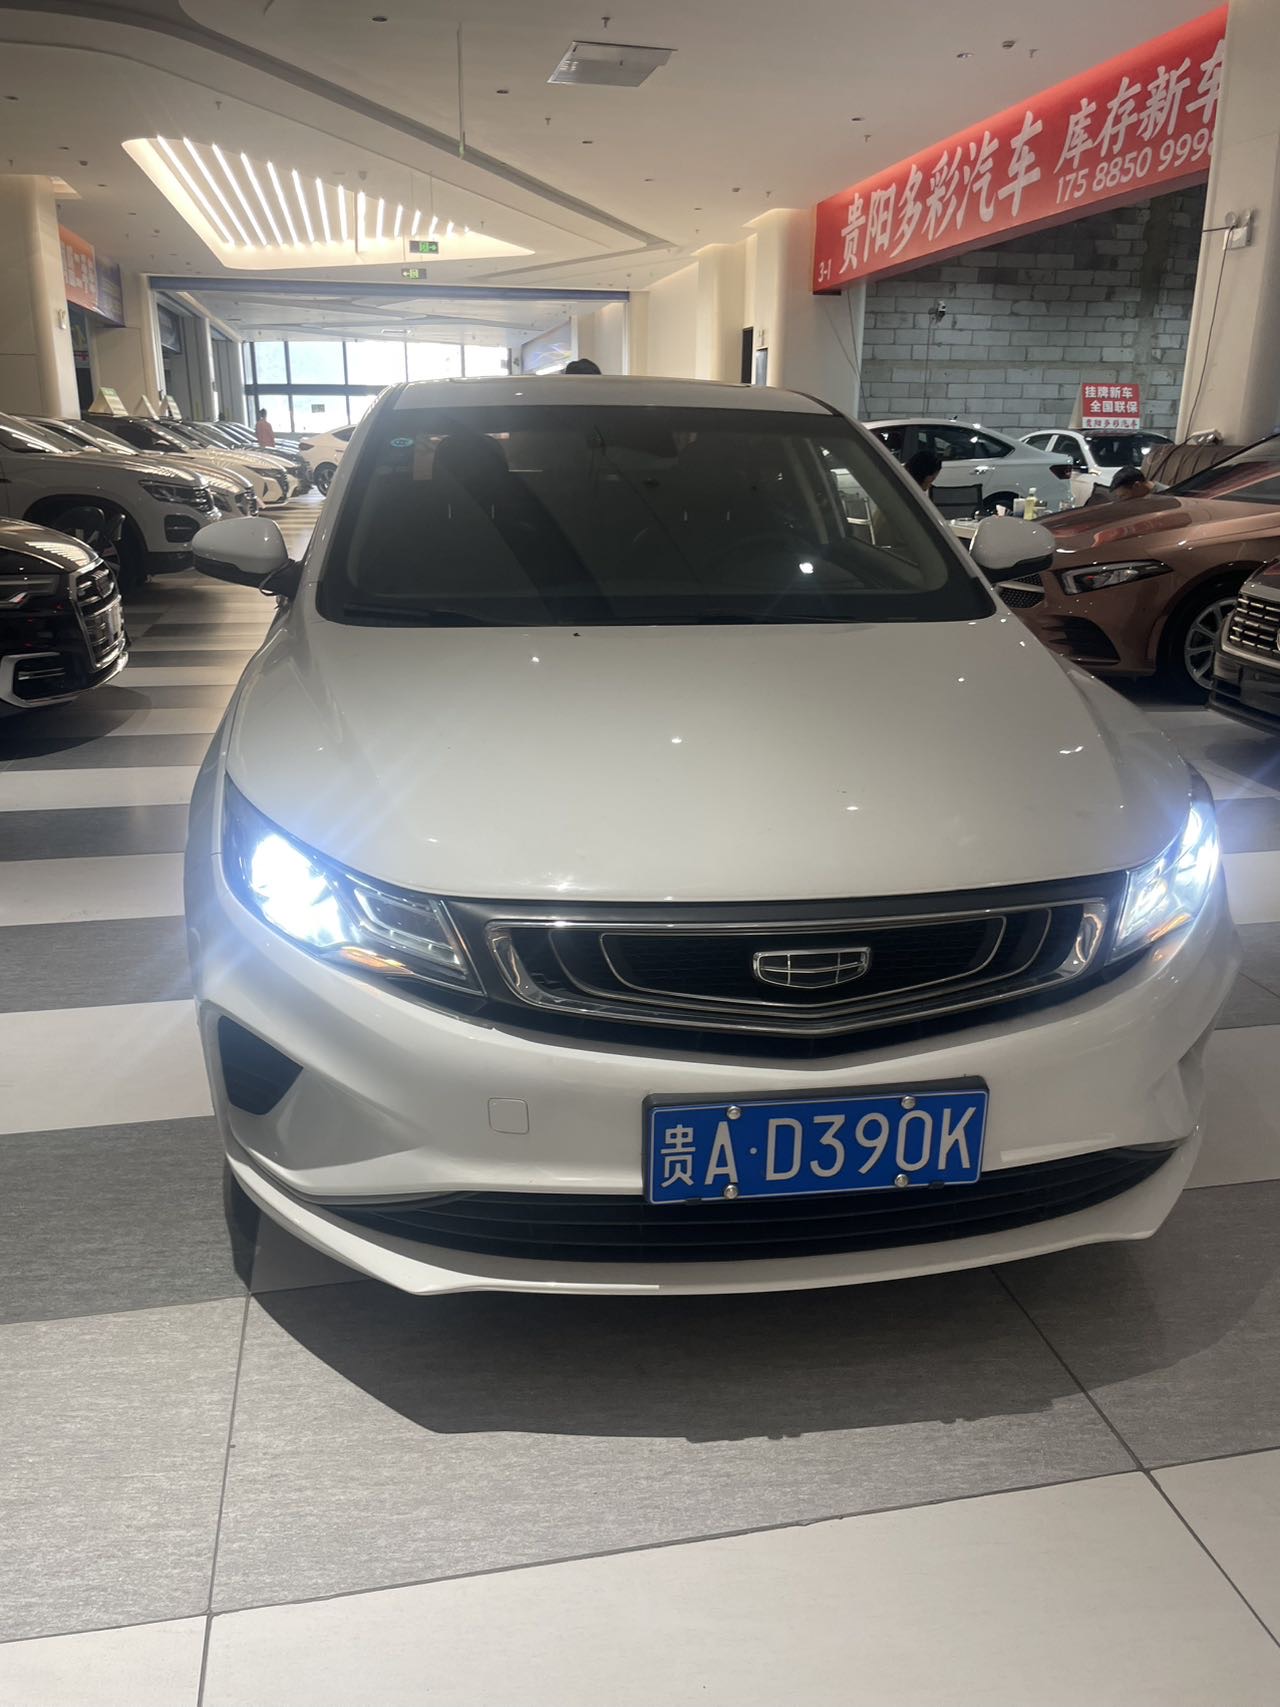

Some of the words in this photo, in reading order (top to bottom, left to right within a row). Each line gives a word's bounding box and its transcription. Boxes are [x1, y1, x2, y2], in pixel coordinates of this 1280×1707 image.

[839, 110, 1043, 274] 贵阳多彩汽车
[1053, 38, 1226, 174] 库存新车
[1056, 167, 1089, 204] 175
[1092, 146, 1152, 192] 8850
[818, 258, 832, 282] 3-1
[1085, 386, 1133, 399] 挂牌新车
[1090, 400, 1138, 413] 全国联保
[660, 1106, 977, 1188] 贵A·D390K
